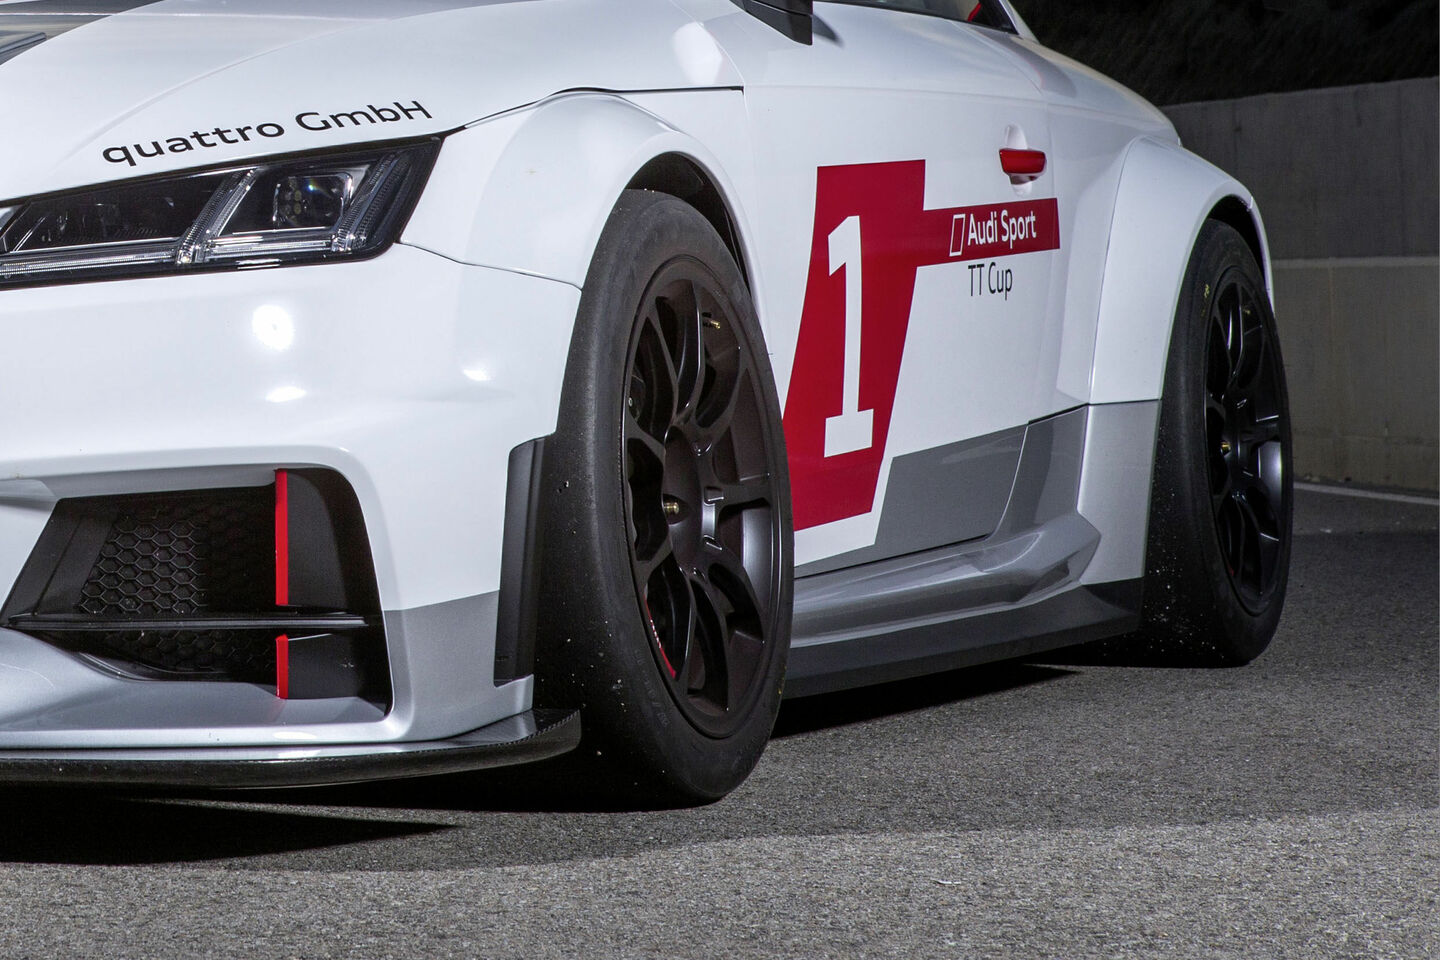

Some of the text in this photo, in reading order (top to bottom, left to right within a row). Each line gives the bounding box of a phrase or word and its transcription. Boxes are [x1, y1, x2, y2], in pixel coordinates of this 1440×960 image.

[102, 100, 433, 167] quattro GmbH
[967, 209, 1037, 249] Audi Sport
[967, 261, 1013, 301] TT Cup
[823, 215, 875, 458] 1
